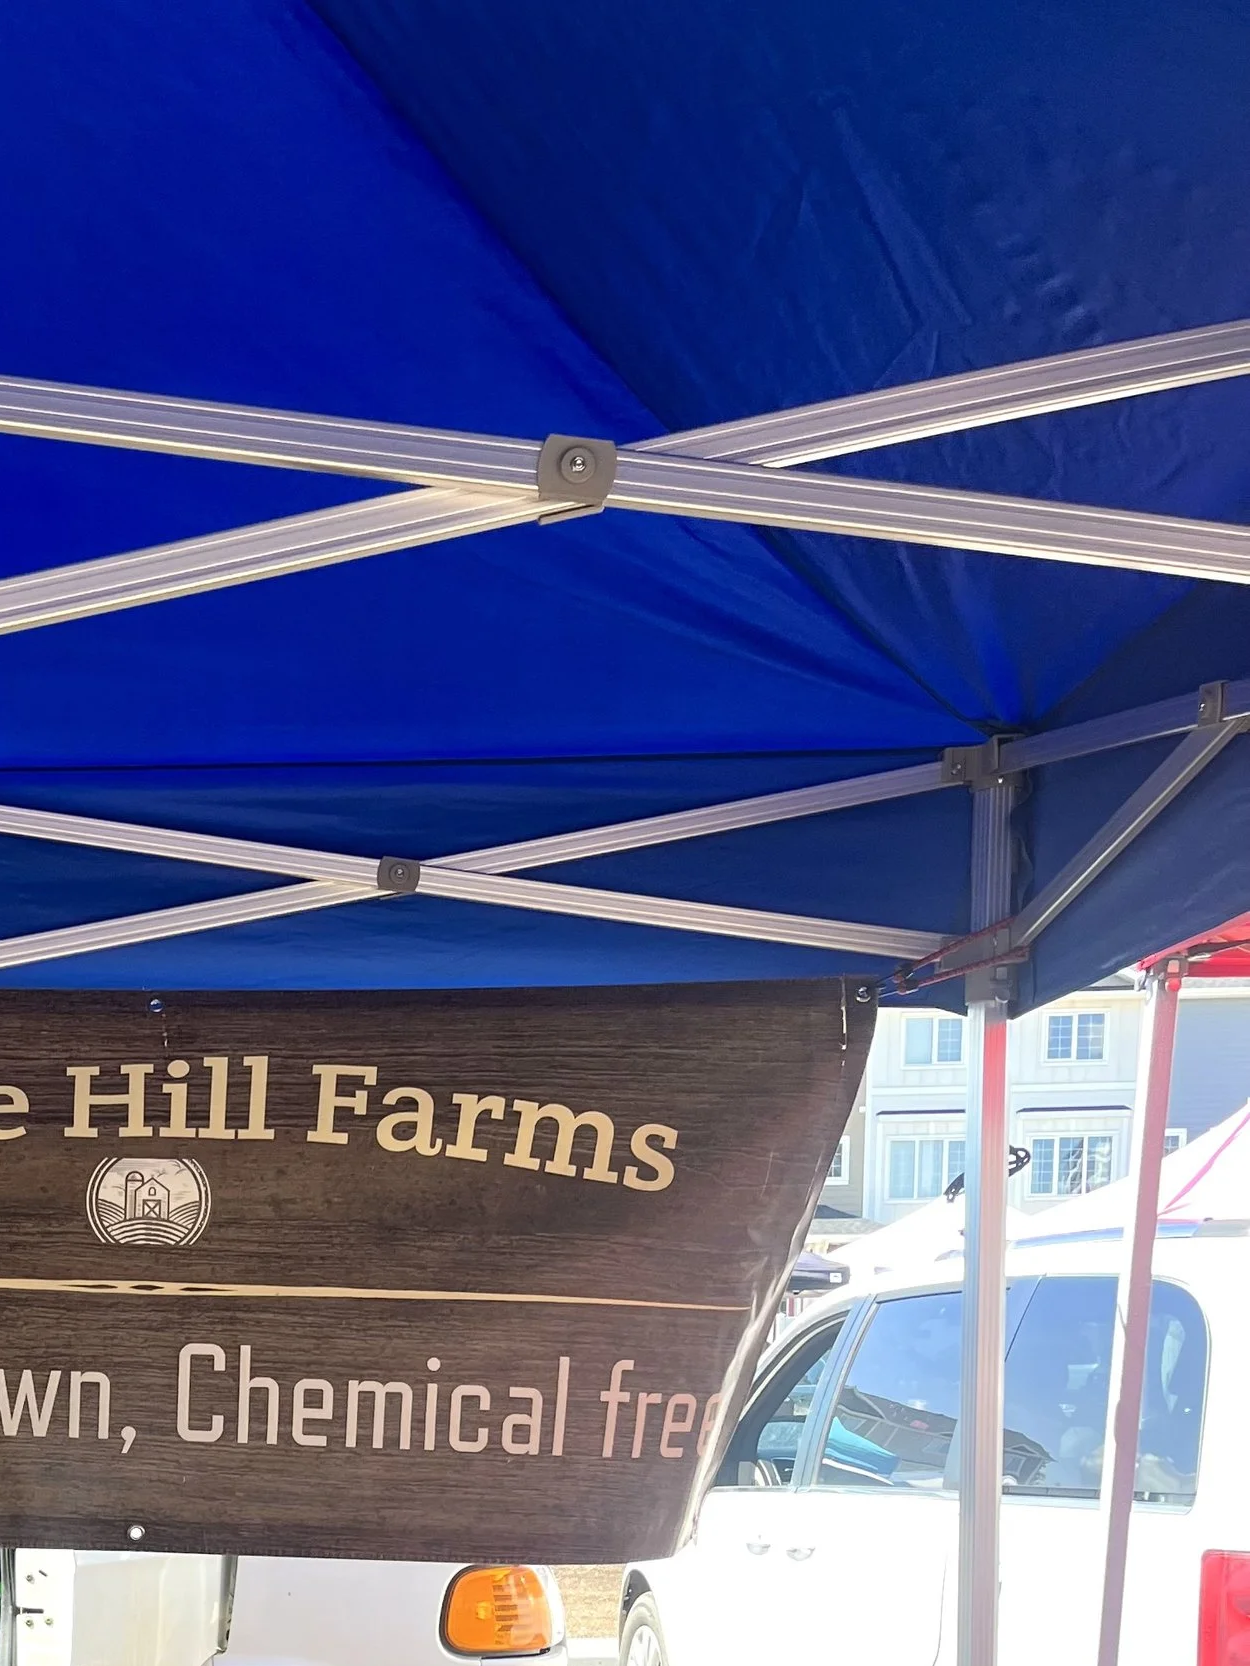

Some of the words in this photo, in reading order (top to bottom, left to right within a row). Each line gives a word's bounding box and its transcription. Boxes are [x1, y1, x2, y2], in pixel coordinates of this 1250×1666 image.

[63, 1055, 276, 1141] Hill
[306, 1064, 679, 1192] Farms
[176, 1343, 570, 1458] Chemical
